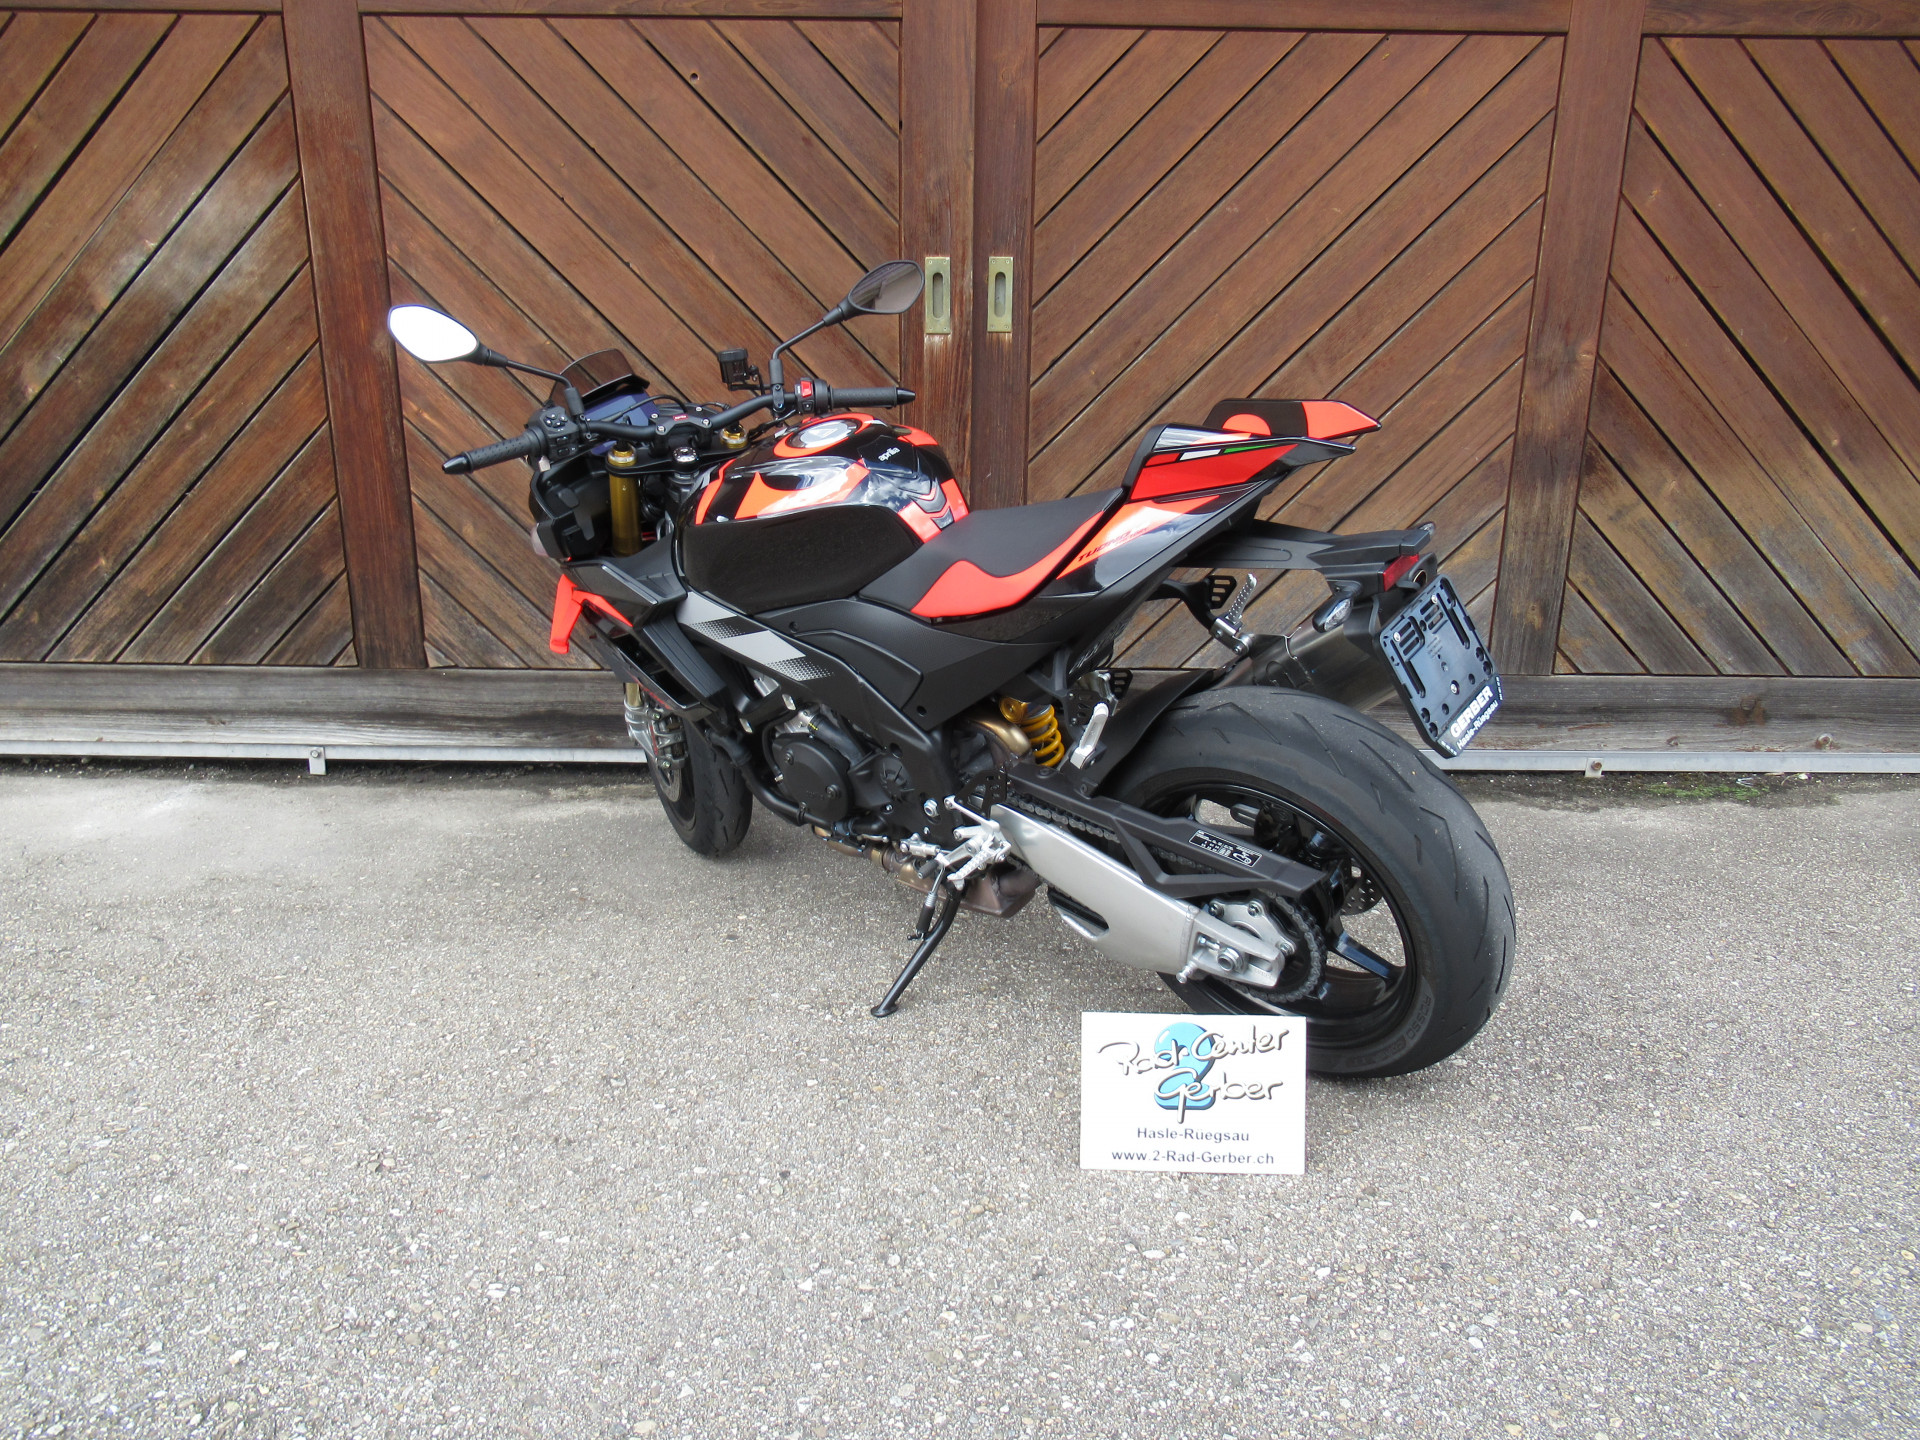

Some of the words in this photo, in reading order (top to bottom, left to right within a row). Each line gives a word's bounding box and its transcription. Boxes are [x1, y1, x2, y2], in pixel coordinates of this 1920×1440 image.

[1450, 685, 1493, 738] GERBER
[1156, 1067, 1284, 1124] Gerber
[1136, 1127, 1250, 1144] Hasle-Rüegsau
[1111, 1150, 1275, 1165] www.2-Rad-Gerber.ch
